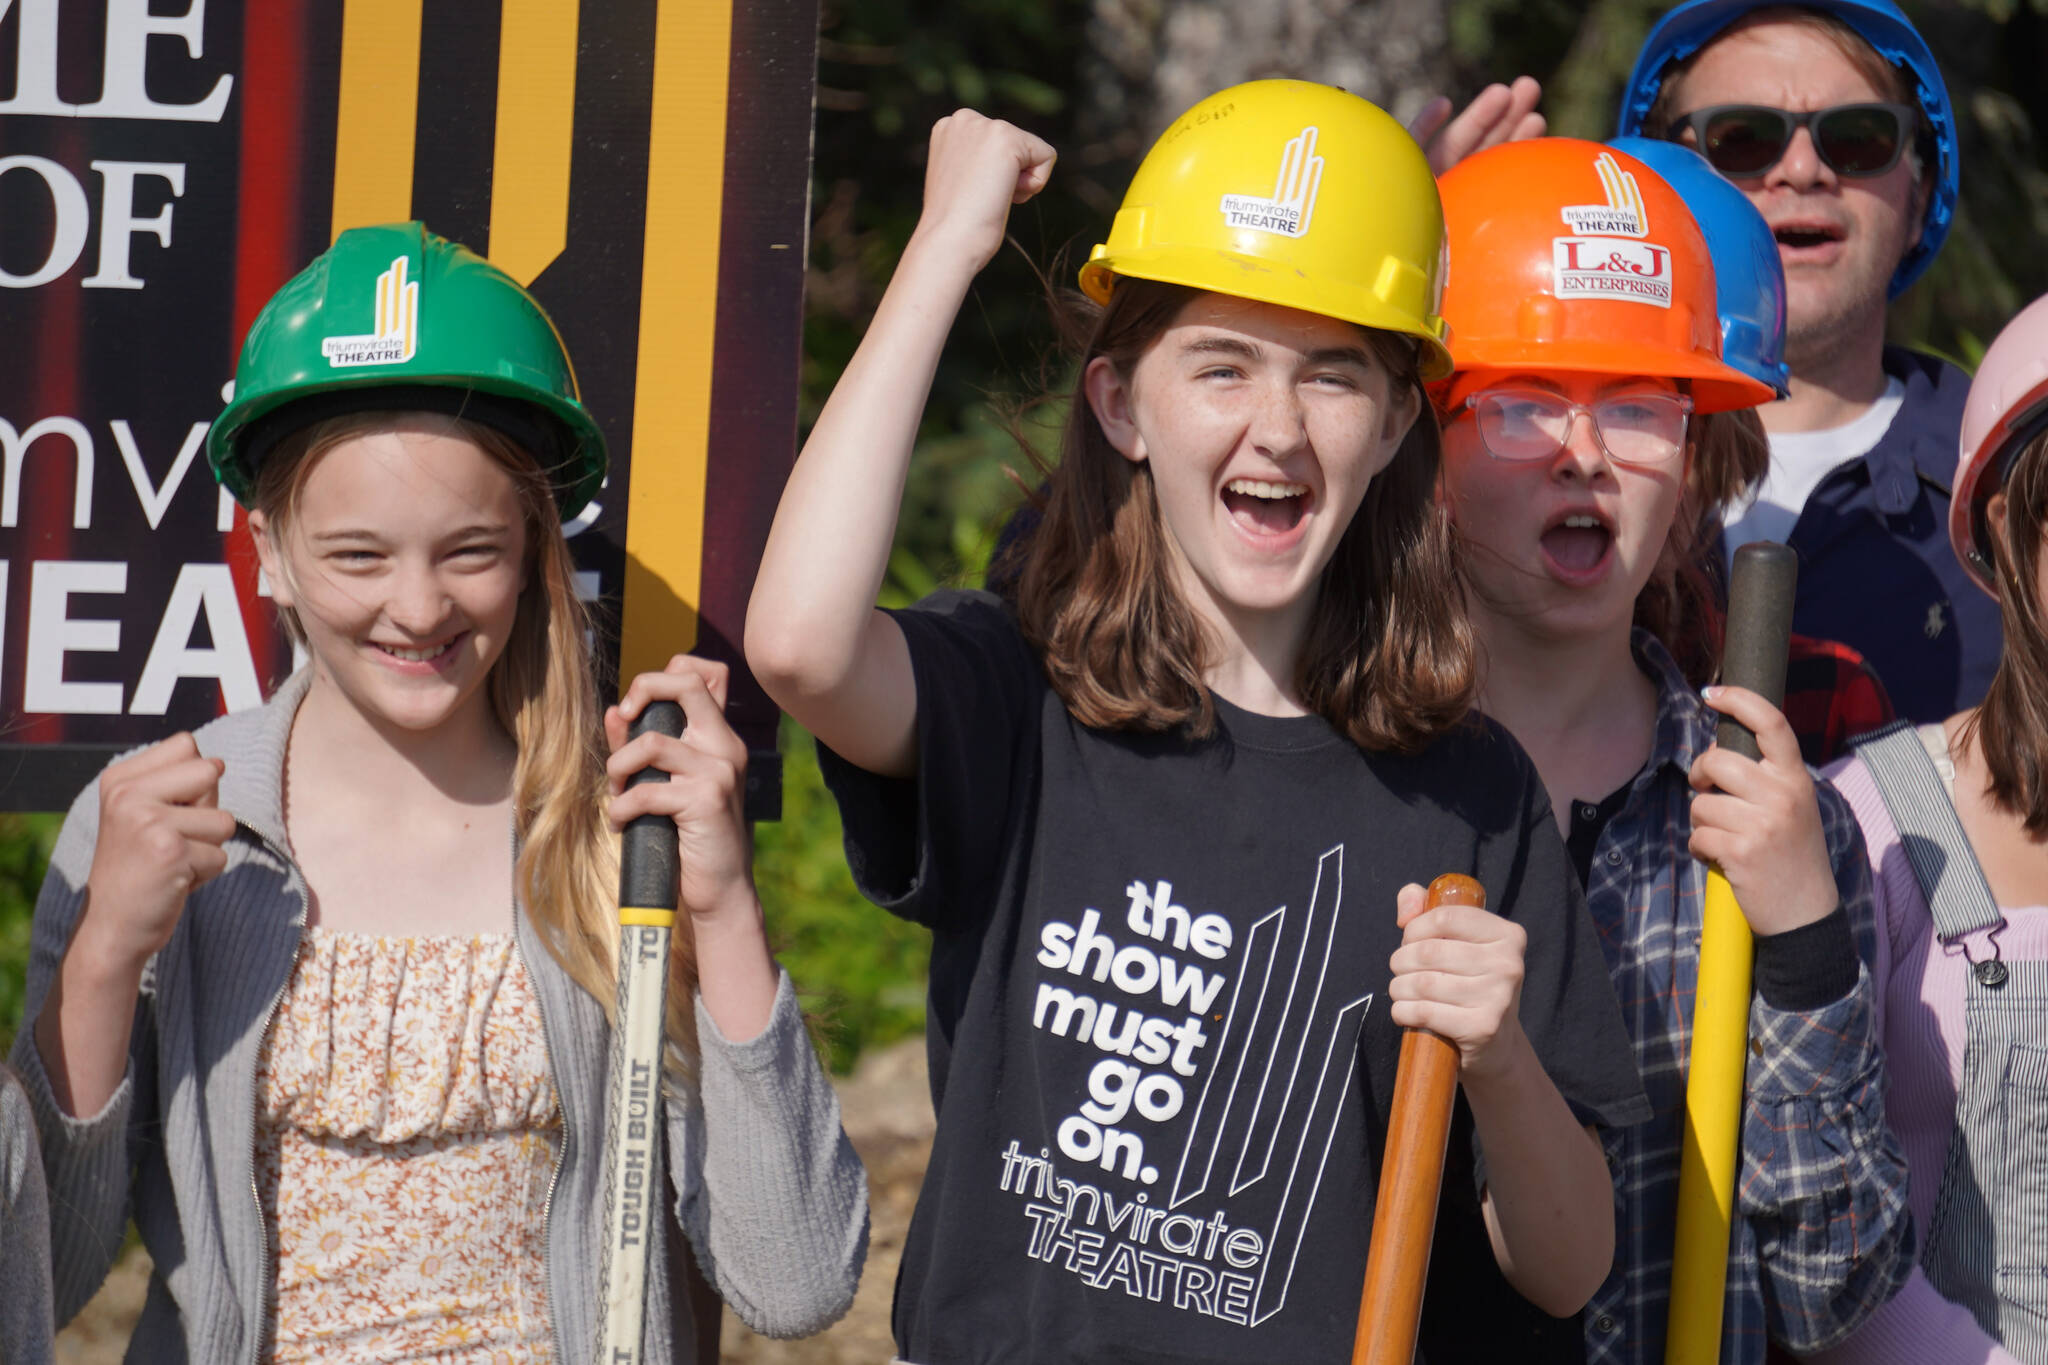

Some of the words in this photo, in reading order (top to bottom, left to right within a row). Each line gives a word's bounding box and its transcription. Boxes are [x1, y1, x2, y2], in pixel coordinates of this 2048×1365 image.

[0, 155, 185, 289] OF
[1225, 197, 1299, 220] triumvirate
[1231, 211, 1297, 233] THEATRE
[1567, 208, 1638, 222] triumvirate
[1577, 221, 1640, 234] THEATRE
[1559, 242, 1668, 277] L&J
[1562, 276, 1669, 298] ENTERPRISES
[327, 339, 403, 353] triumvirate
[336, 349, 402, 363] THEATRE
[1126, 880, 1233, 959] the
[1036, 908, 1226, 1016] show
[1033, 983, 1208, 1076] must
[627, 1058, 650, 1141] BUILT
[1080, 1059, 1184, 1126] go
[1057, 1114, 1159, 1185] on.
[620, 1149, 645, 1250] TOUGH
[1025, 1204, 1255, 1326] THEATRE
